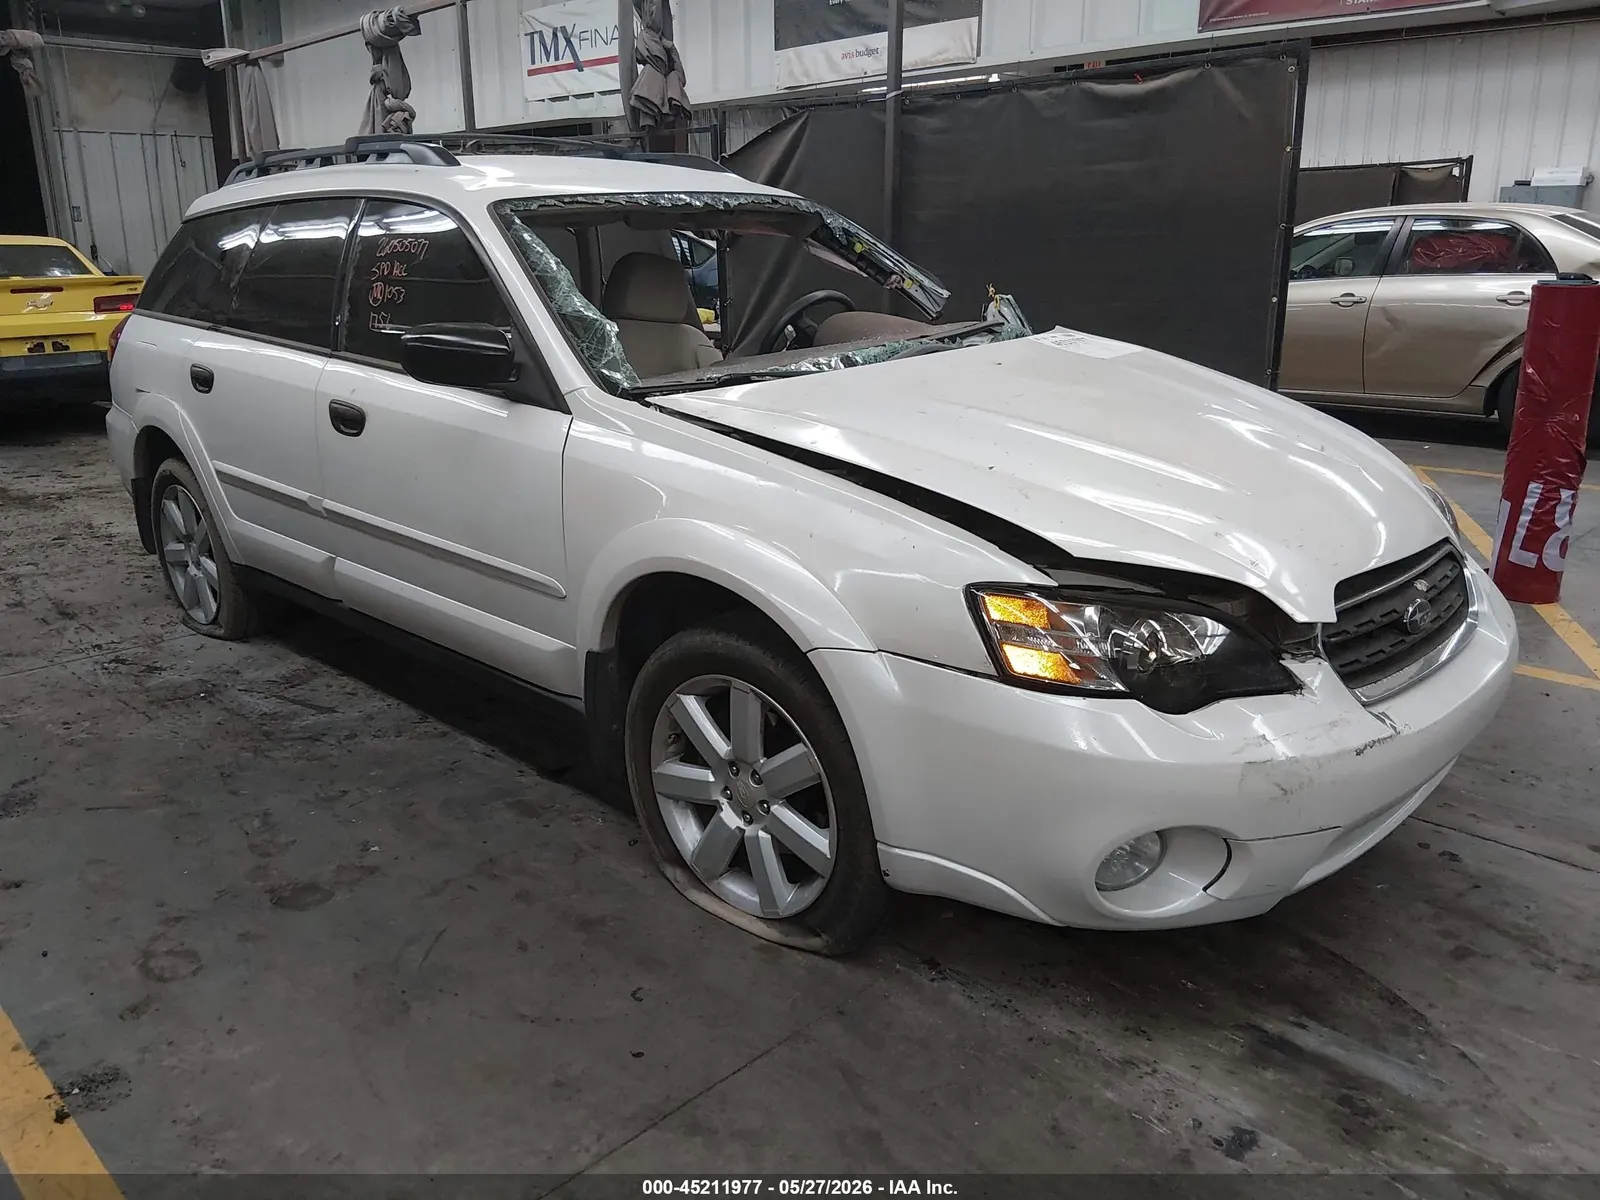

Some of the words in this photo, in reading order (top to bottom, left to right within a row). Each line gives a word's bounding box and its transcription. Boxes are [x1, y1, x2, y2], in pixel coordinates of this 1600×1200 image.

[524, 23, 585, 73] TMX
[840, 52, 855, 61] avis
[855, 47, 880, 59] budget
[370, 261, 391, 280] SPD
